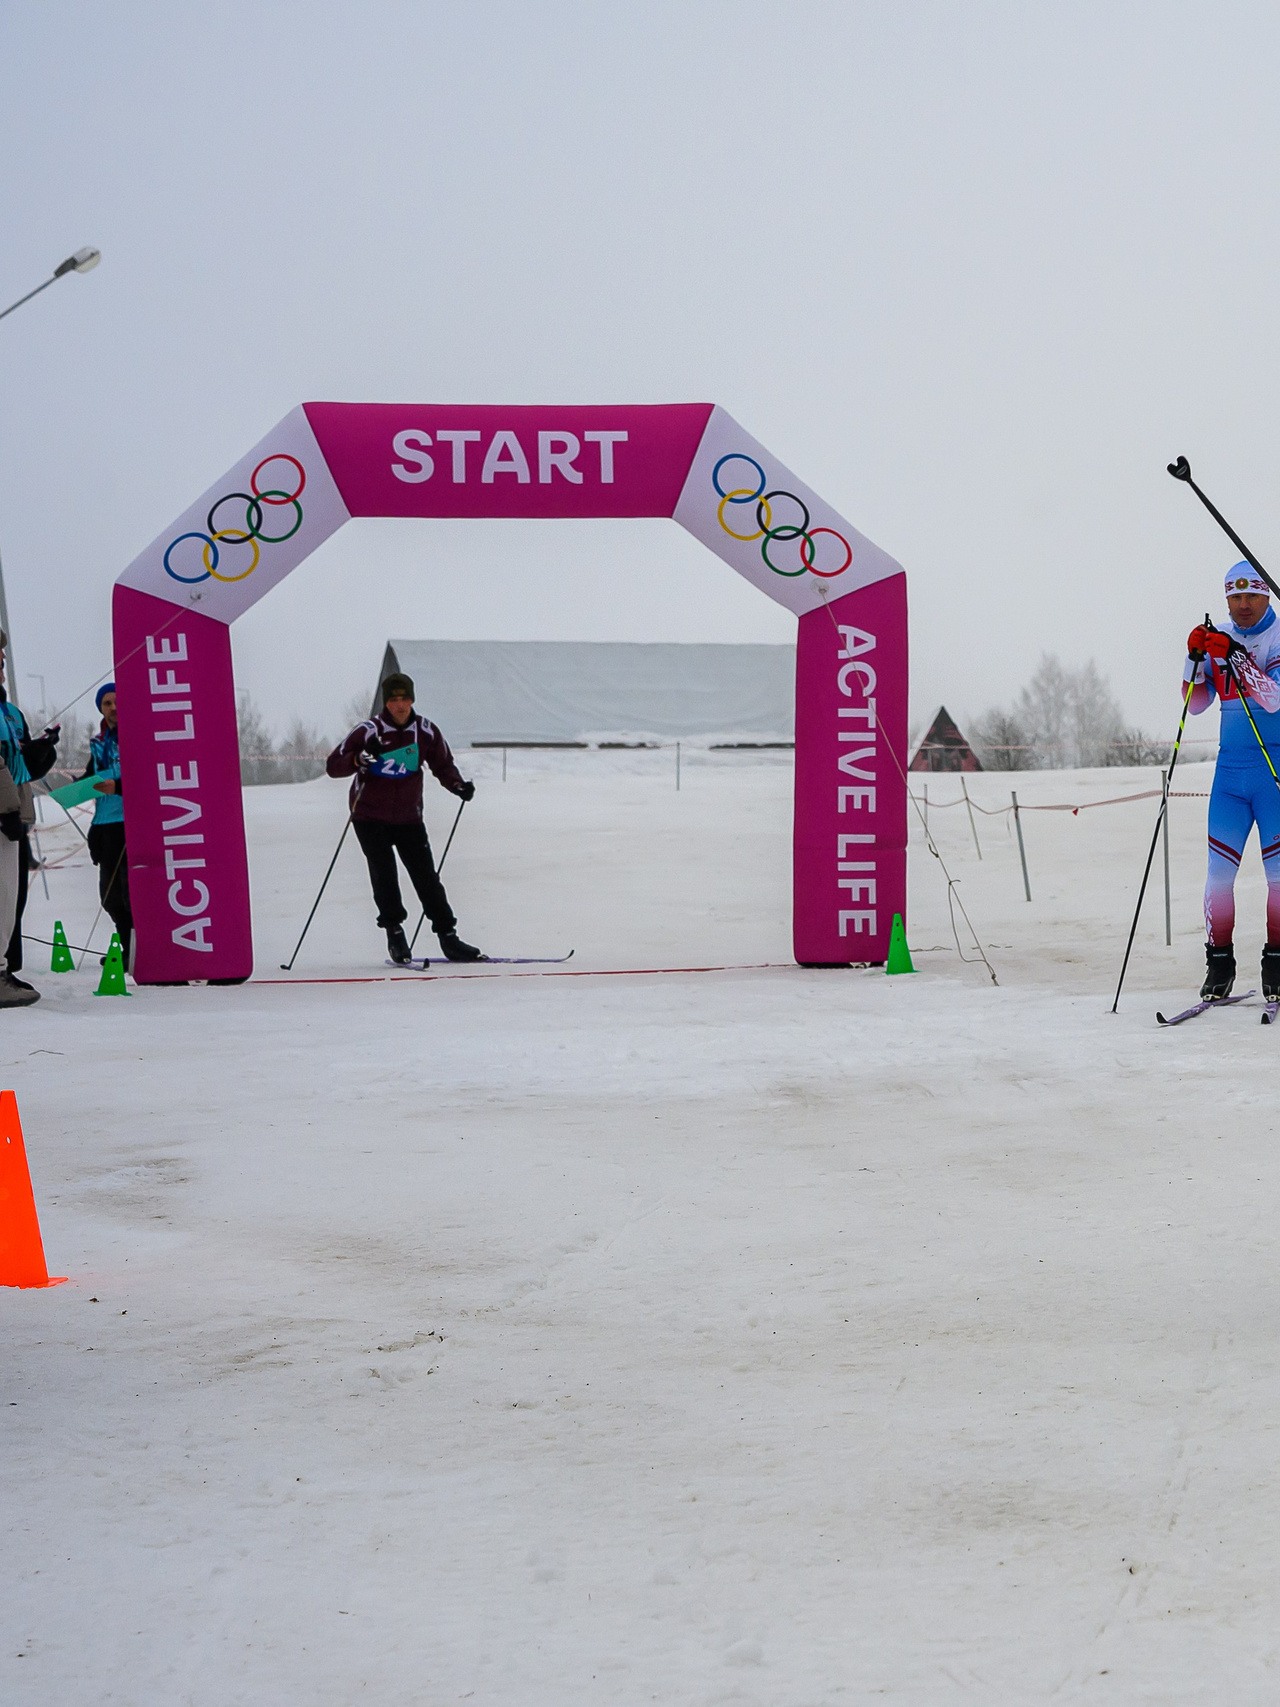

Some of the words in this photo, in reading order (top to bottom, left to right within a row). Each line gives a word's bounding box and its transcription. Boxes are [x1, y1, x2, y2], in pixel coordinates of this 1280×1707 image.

[391, 429, 628, 484] START
[146, 633, 195, 741] LIFE
[837, 625, 877, 813] ACTIVE
[157, 761, 213, 952] ACTIVE
[837, 834, 877, 937] LIFE
